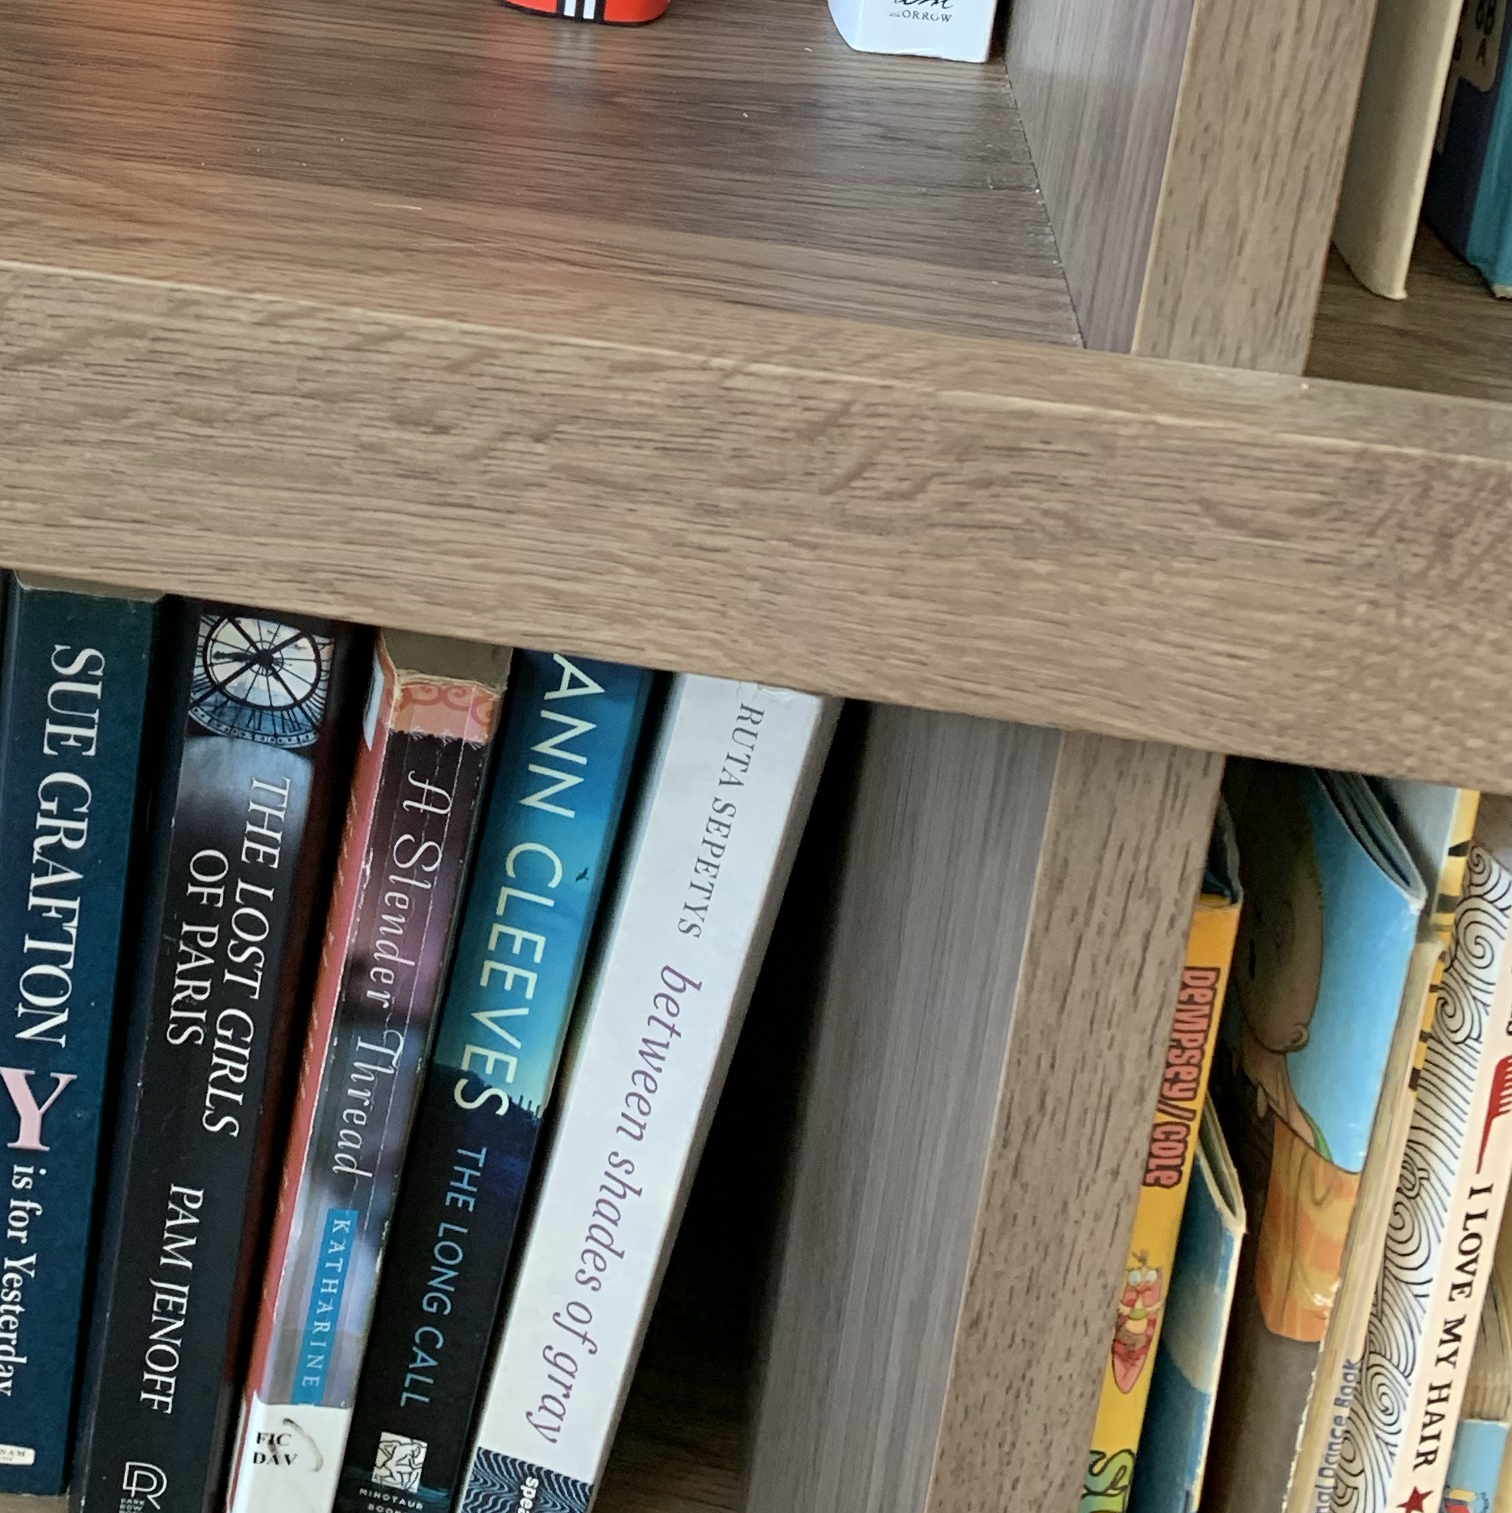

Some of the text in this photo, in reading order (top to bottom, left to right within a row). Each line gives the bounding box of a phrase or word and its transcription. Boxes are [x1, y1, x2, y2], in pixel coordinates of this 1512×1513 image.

[453, 652, 607, 1117] ANN CLEEVES
[676, 701, 766, 940] RUTA SEPETYS
[166, 848, 230, 1048] OF PARIS
[201, 775, 292, 1139] THE LOST GIRLS
[6, 1197, 44, 1244] for
[13, 1163, 47, 1190] is
[524, 963, 704, 1446] between shades of gray
[139, 1182, 205, 1416] PAM JENOFF
[301, 1217, 352, 1389] KATHARINE
[1413, 1182, 1494, 1475] I LOVE MY HAIR
[251, 1451, 299, 1467] DAV
[255, 1431, 292, 1448] FIC
